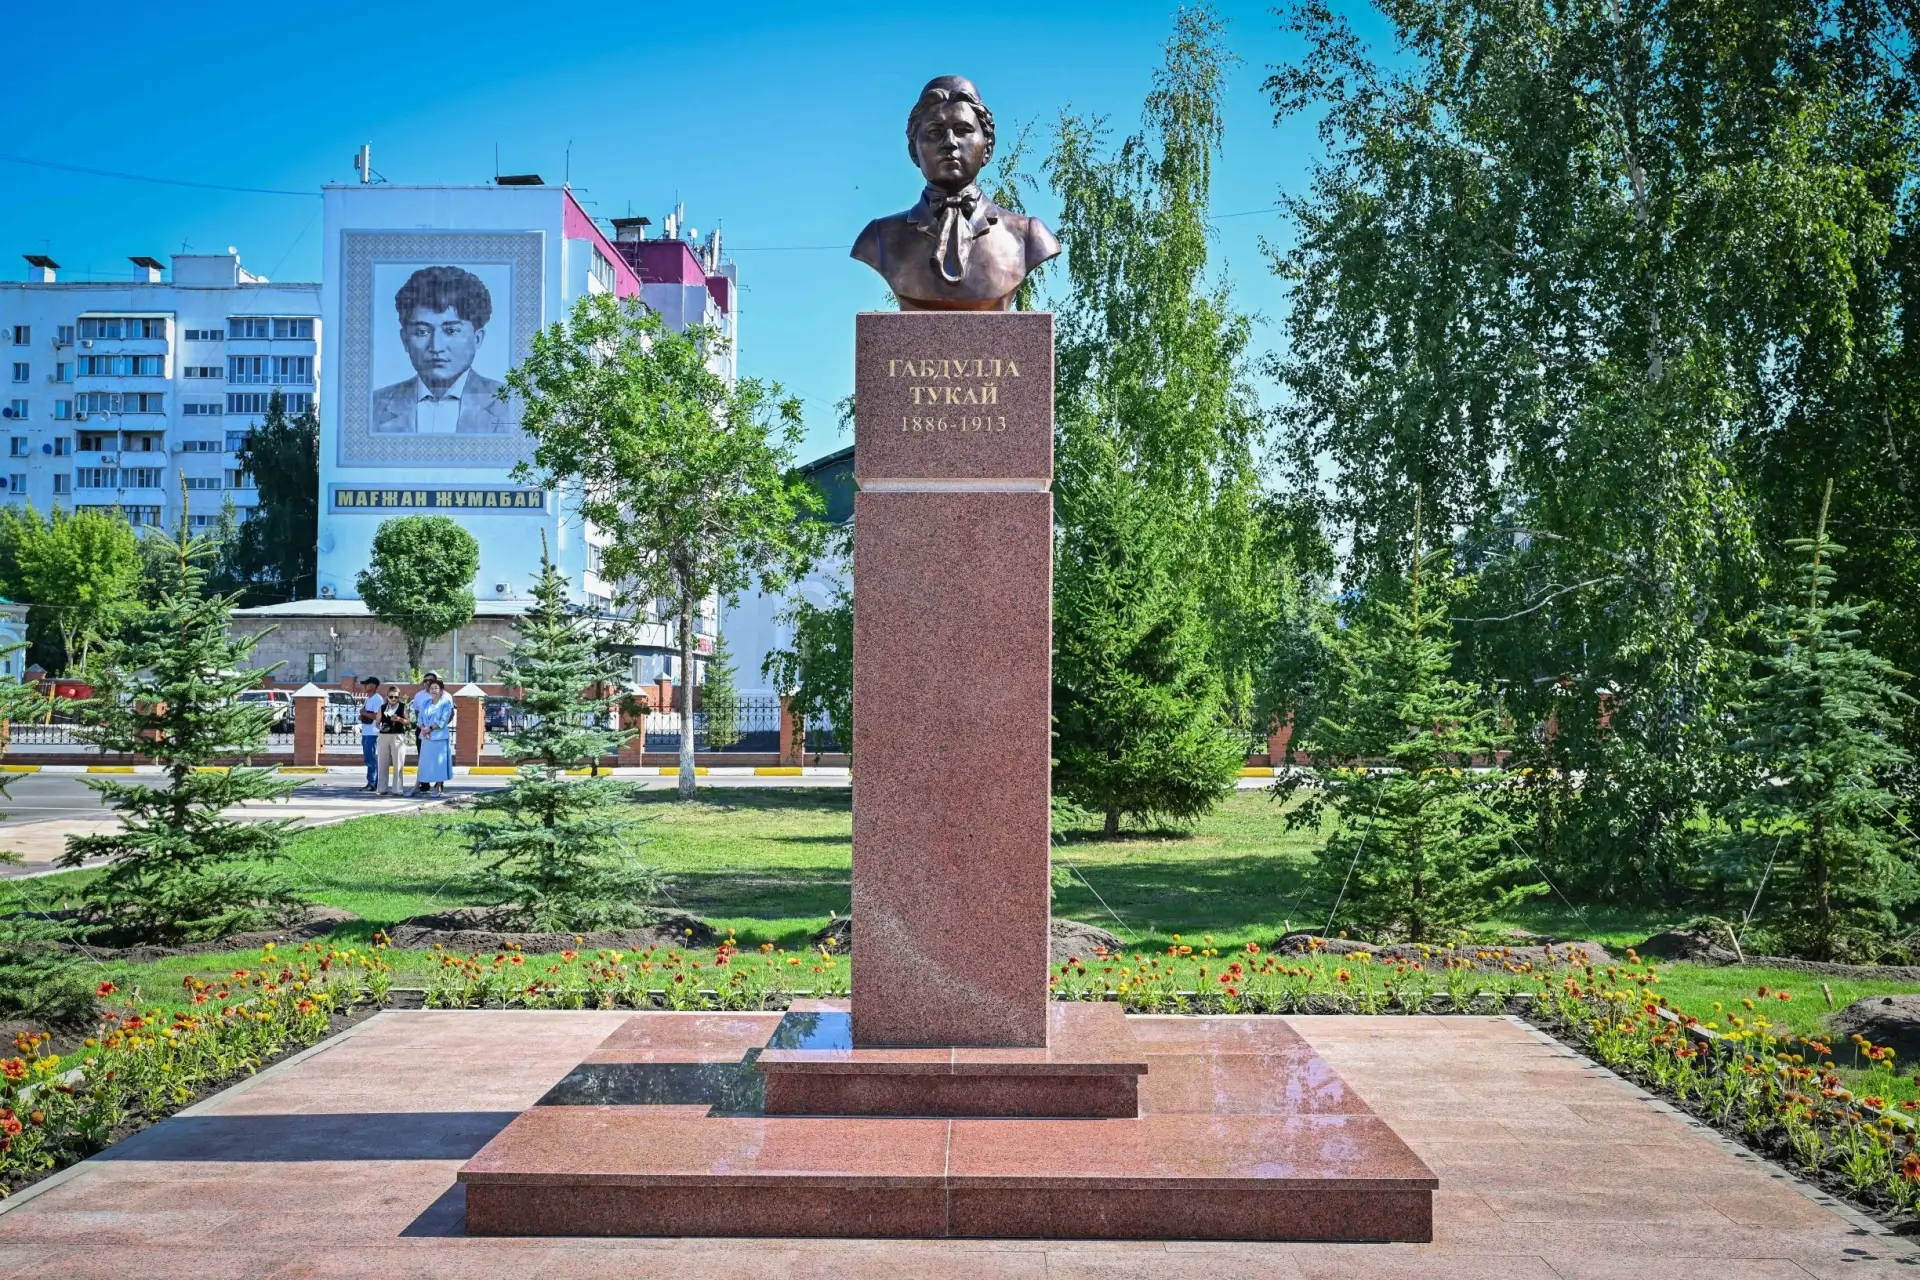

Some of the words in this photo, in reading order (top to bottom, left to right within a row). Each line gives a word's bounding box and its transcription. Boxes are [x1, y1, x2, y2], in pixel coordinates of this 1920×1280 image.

[888, 359, 1020, 381] ГАБДУЛЛА
[909, 382, 998, 405] ТУКАЙ
[901, 416, 1007, 432] 1886-1913
